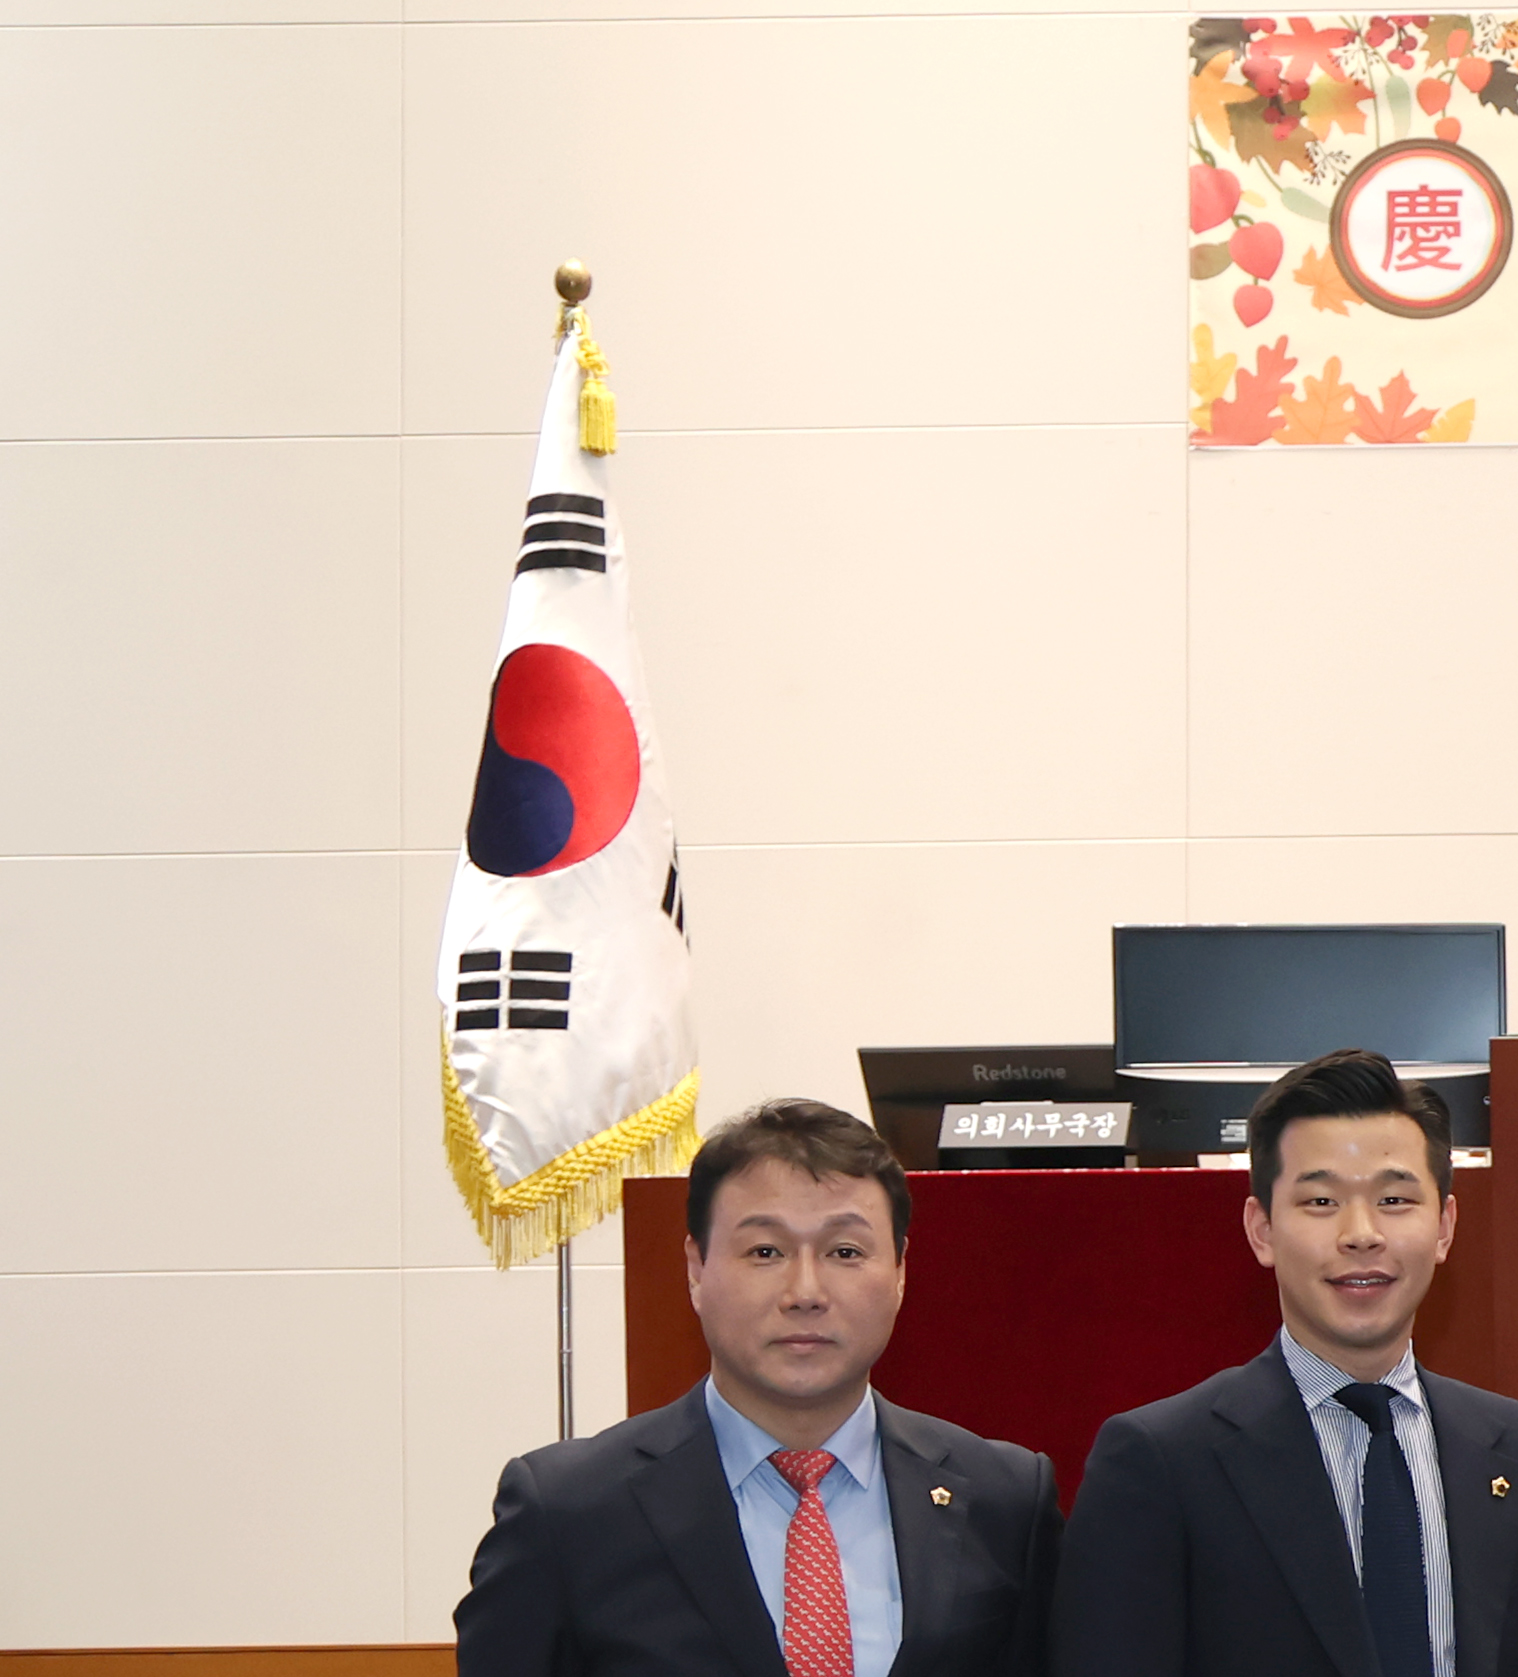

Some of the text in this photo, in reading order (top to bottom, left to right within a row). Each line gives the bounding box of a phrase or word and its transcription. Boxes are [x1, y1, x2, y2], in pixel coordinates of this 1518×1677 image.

[1380, 184, 1464, 272] 慶
[971, 1063, 1068, 1082] Redstone
[953, 1111, 1118, 1140] 의회사무국장
